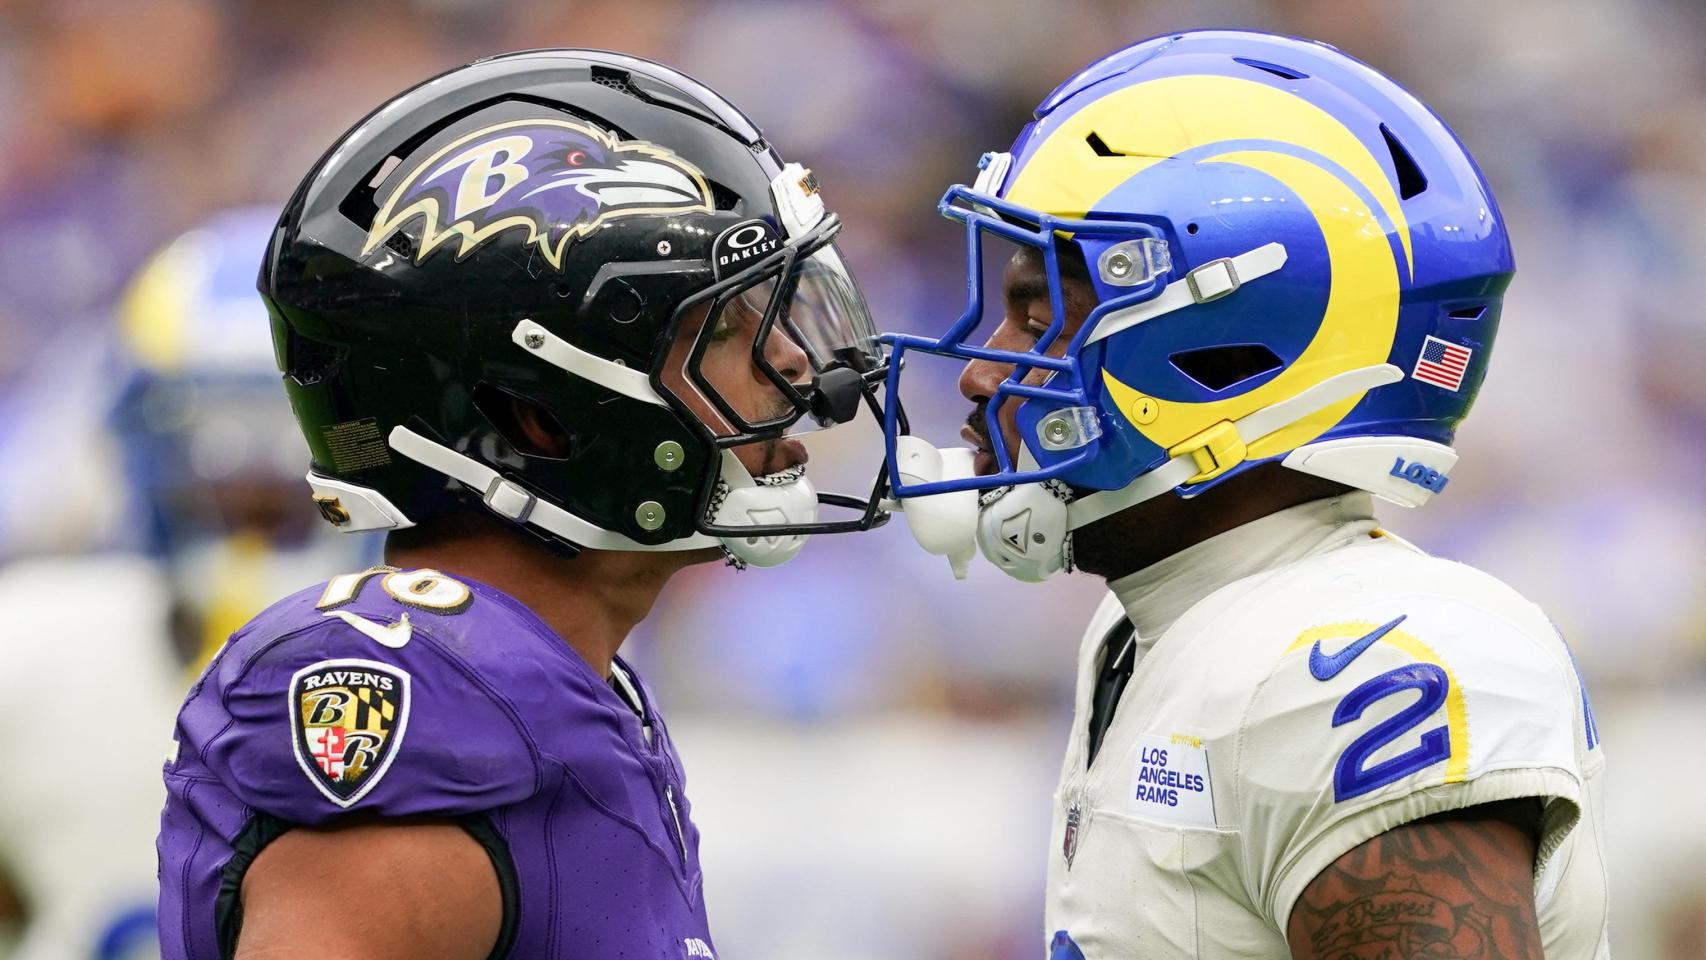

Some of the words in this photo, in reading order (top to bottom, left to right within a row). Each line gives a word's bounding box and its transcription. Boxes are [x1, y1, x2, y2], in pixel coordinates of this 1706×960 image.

[421, 135, 534, 221] B
[720, 239, 777, 266] OAKLEY
[303, 671, 393, 691] RAVENS
[304, 691, 350, 725] B
[1331, 663, 1451, 804] 2
[343, 730, 382, 770] R
[1141, 747, 1168, 767] LOS
[1138, 766, 1204, 793] ANGELES
[1136, 784, 1178, 807] RAMS
